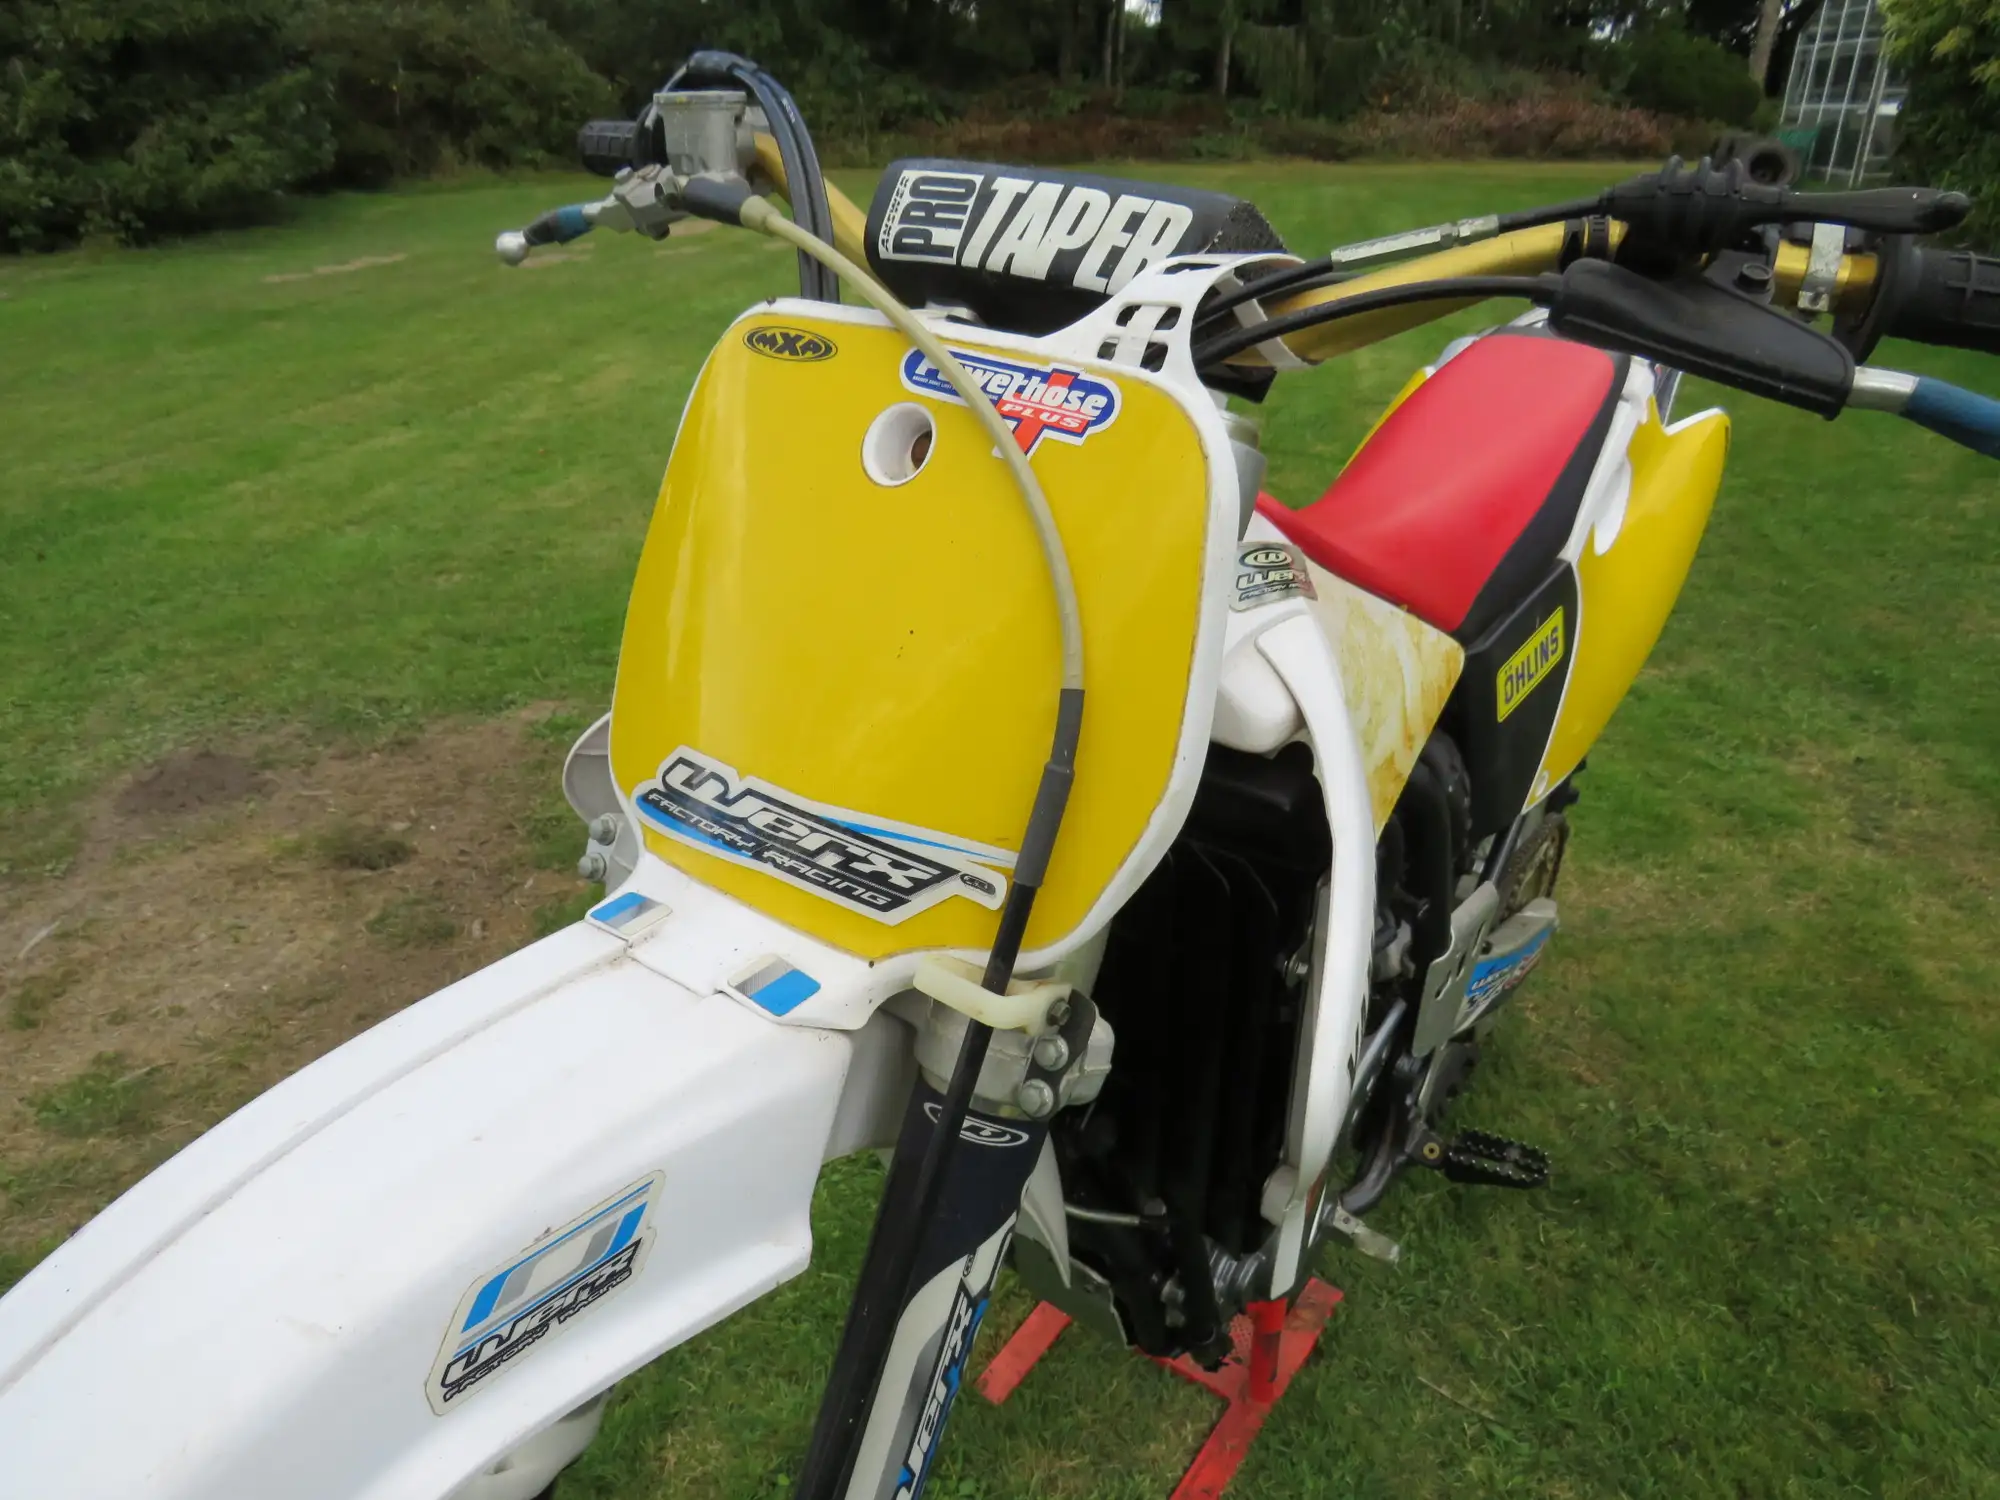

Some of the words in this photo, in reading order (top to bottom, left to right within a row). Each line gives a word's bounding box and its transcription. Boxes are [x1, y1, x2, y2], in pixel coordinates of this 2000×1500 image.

[892, 176, 977, 259] PRO
[961, 176, 1193, 295] TAPER
[1001, 403, 1083, 429] PLUS
[1504, 626, 1559, 705] ÖHLINS
[648, 793, 756, 849] FACTORY
[762, 850, 893, 905] RACING
